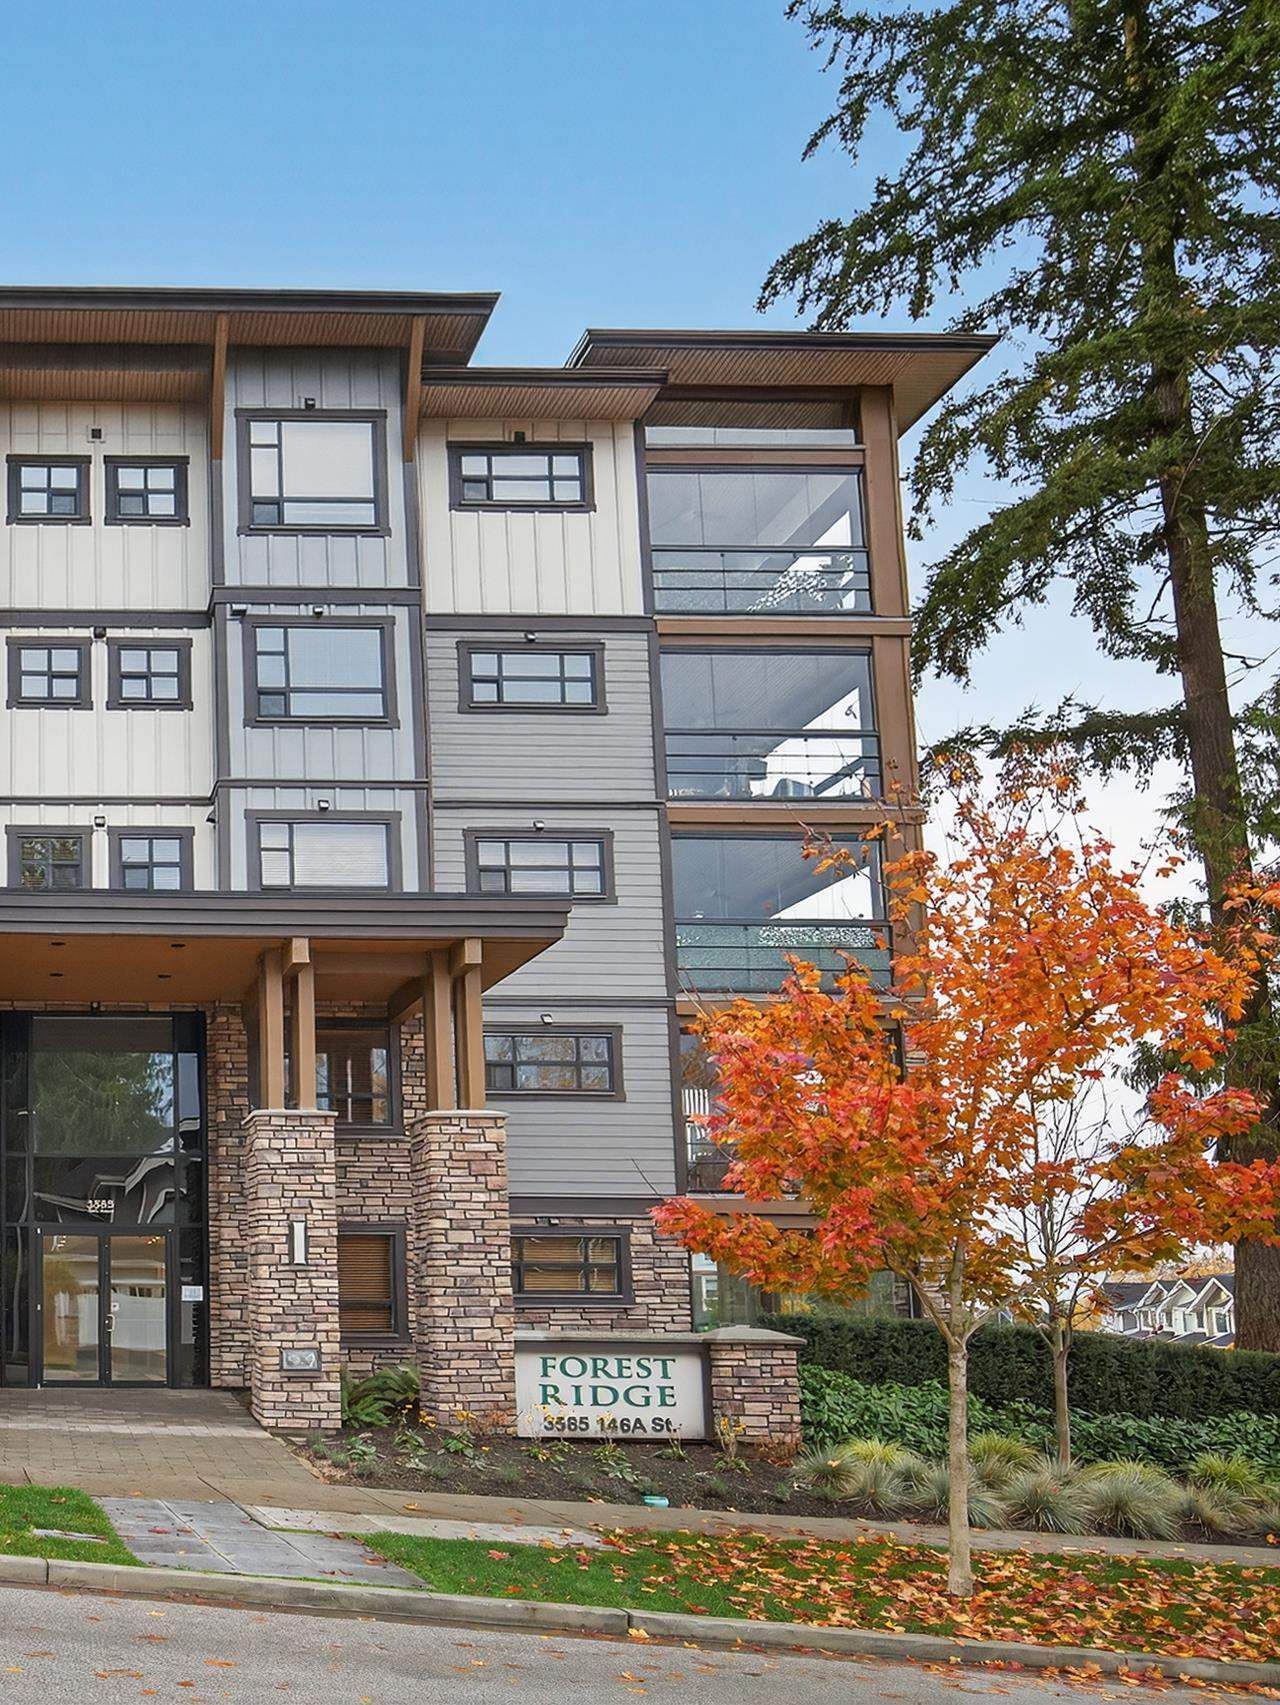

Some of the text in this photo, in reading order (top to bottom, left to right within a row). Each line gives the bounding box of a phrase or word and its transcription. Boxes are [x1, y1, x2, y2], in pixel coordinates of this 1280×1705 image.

[539, 1356, 676, 1379] FOREST
[539, 1383, 677, 1407] RIDGE
[597, 1417, 648, 1434] 146A
